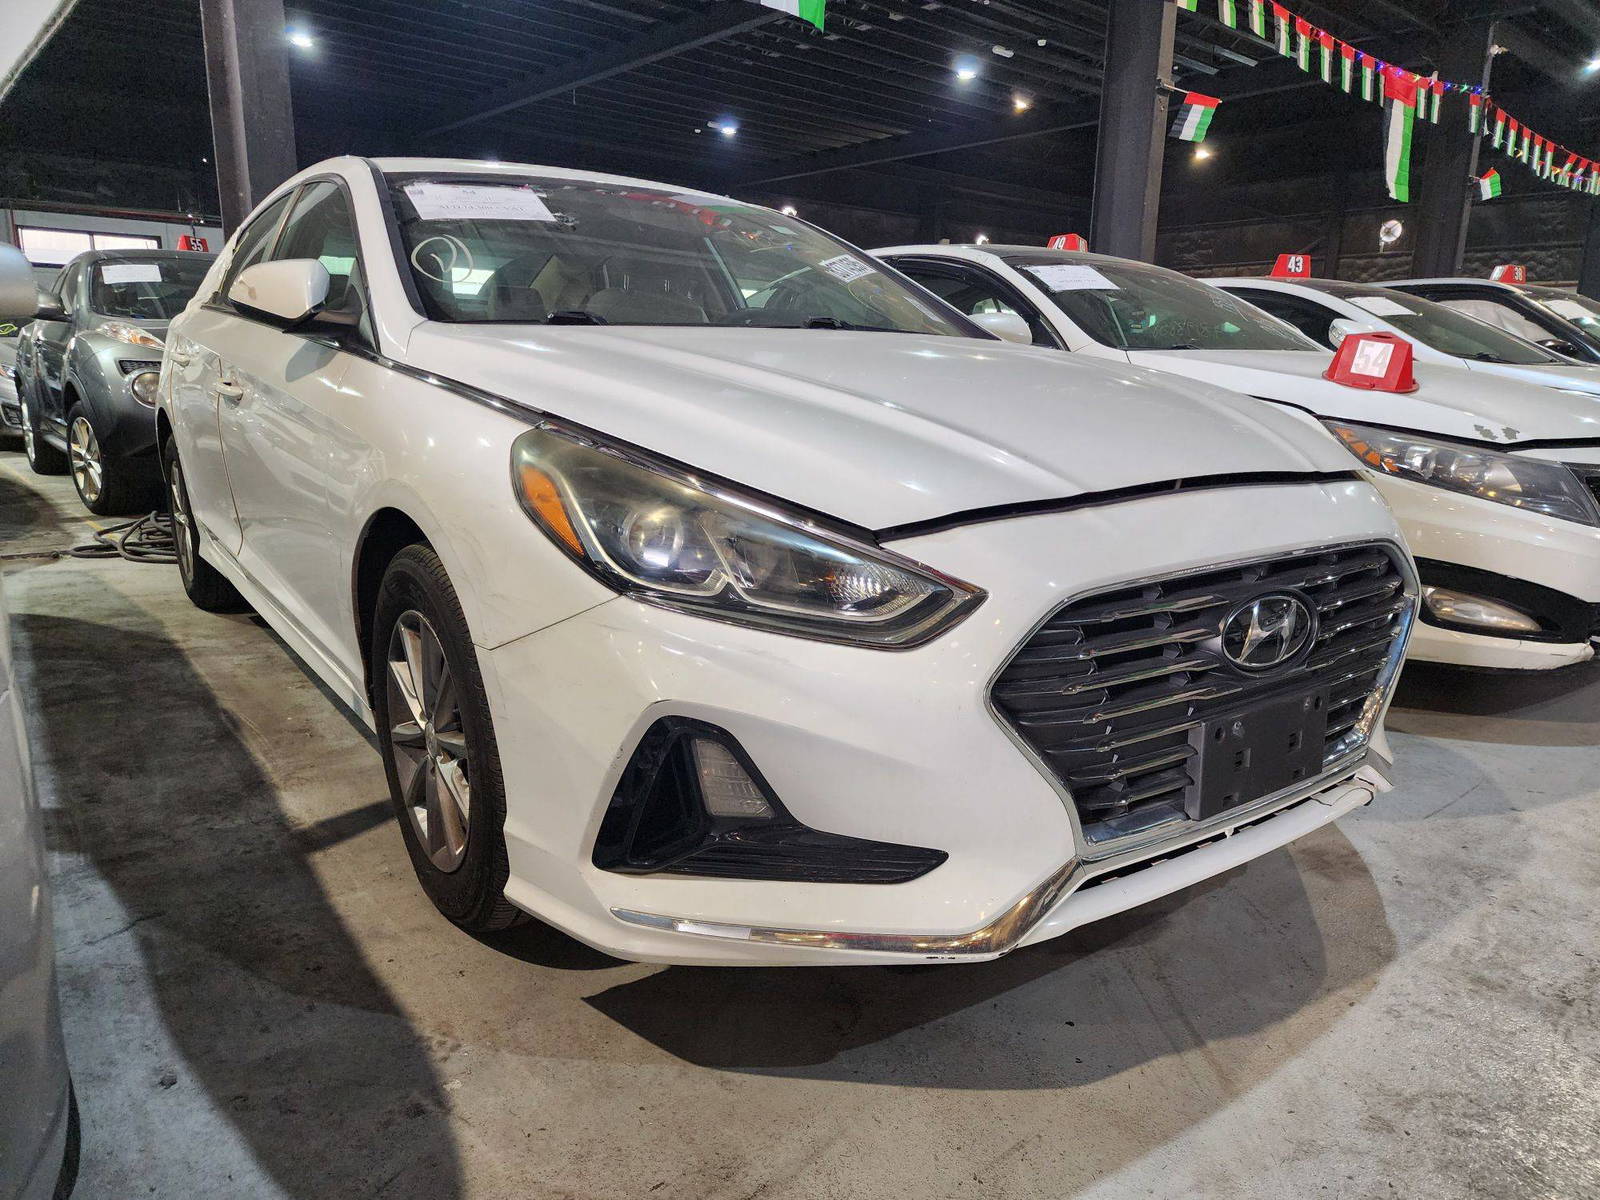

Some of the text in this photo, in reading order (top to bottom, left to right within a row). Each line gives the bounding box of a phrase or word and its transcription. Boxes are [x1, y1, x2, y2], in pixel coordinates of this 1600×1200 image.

[190, 237, 204, 251] 55
[1288, 256, 1303, 272] 43
[1354, 341, 1391, 376] 54
